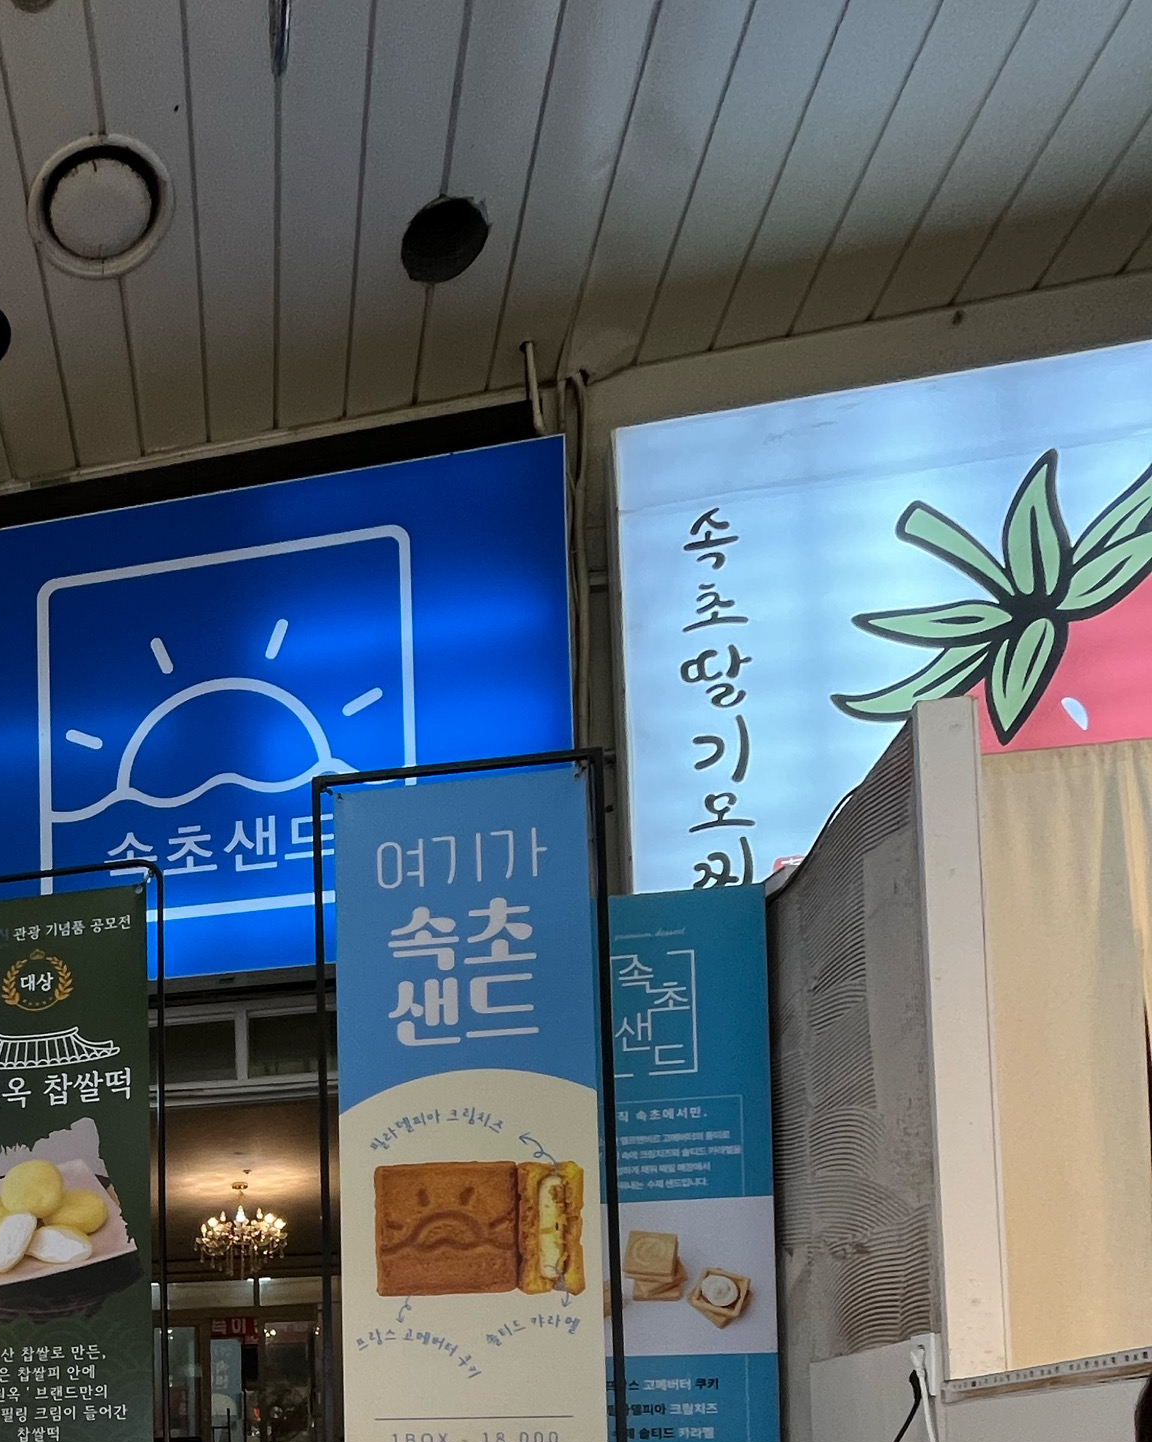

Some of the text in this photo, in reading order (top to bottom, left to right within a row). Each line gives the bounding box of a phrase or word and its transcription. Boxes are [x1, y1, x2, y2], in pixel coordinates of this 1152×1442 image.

[680, 507, 755, 889] 속초딸기모찌
[103, 813, 334, 878] 속초샌드
[376, 827, 547, 889] 여기가
[12, 925, 41, 942] 관광
[46, 921, 86, 938] 기념품
[89, 914, 132, 933] 공모전
[388, 897, 538, 970] 속초
[20, 972, 54, 992] 대상
[388, 972, 540, 1046] 샌드
[43, 1067, 132, 1106] 찹쌀떡
[370, 1109, 440, 1151] 필라델피아
[20, 1345, 65, 1363] 찹쌀로
[71, 1344, 107, 1361] 만든,
[356, 1328, 482, 1379] 프랑스 고메버터 쿠키
[17, 1365, 60, 1382] 찹쌀피
[66, 1364, 96, 1380] 안에
[695, 1377, 719, 1390] 쿠키
[35, 1384, 109, 1401] 브랜드만의
[0, 1407, 27, 1423] 필링
[34, 1405, 77, 1422] 크림이
[83, 1404, 128, 1421] 들어간
[670, 1402, 718, 1415] 크림치즈
[17, 1426, 60, 1442] 찹쌀떡
